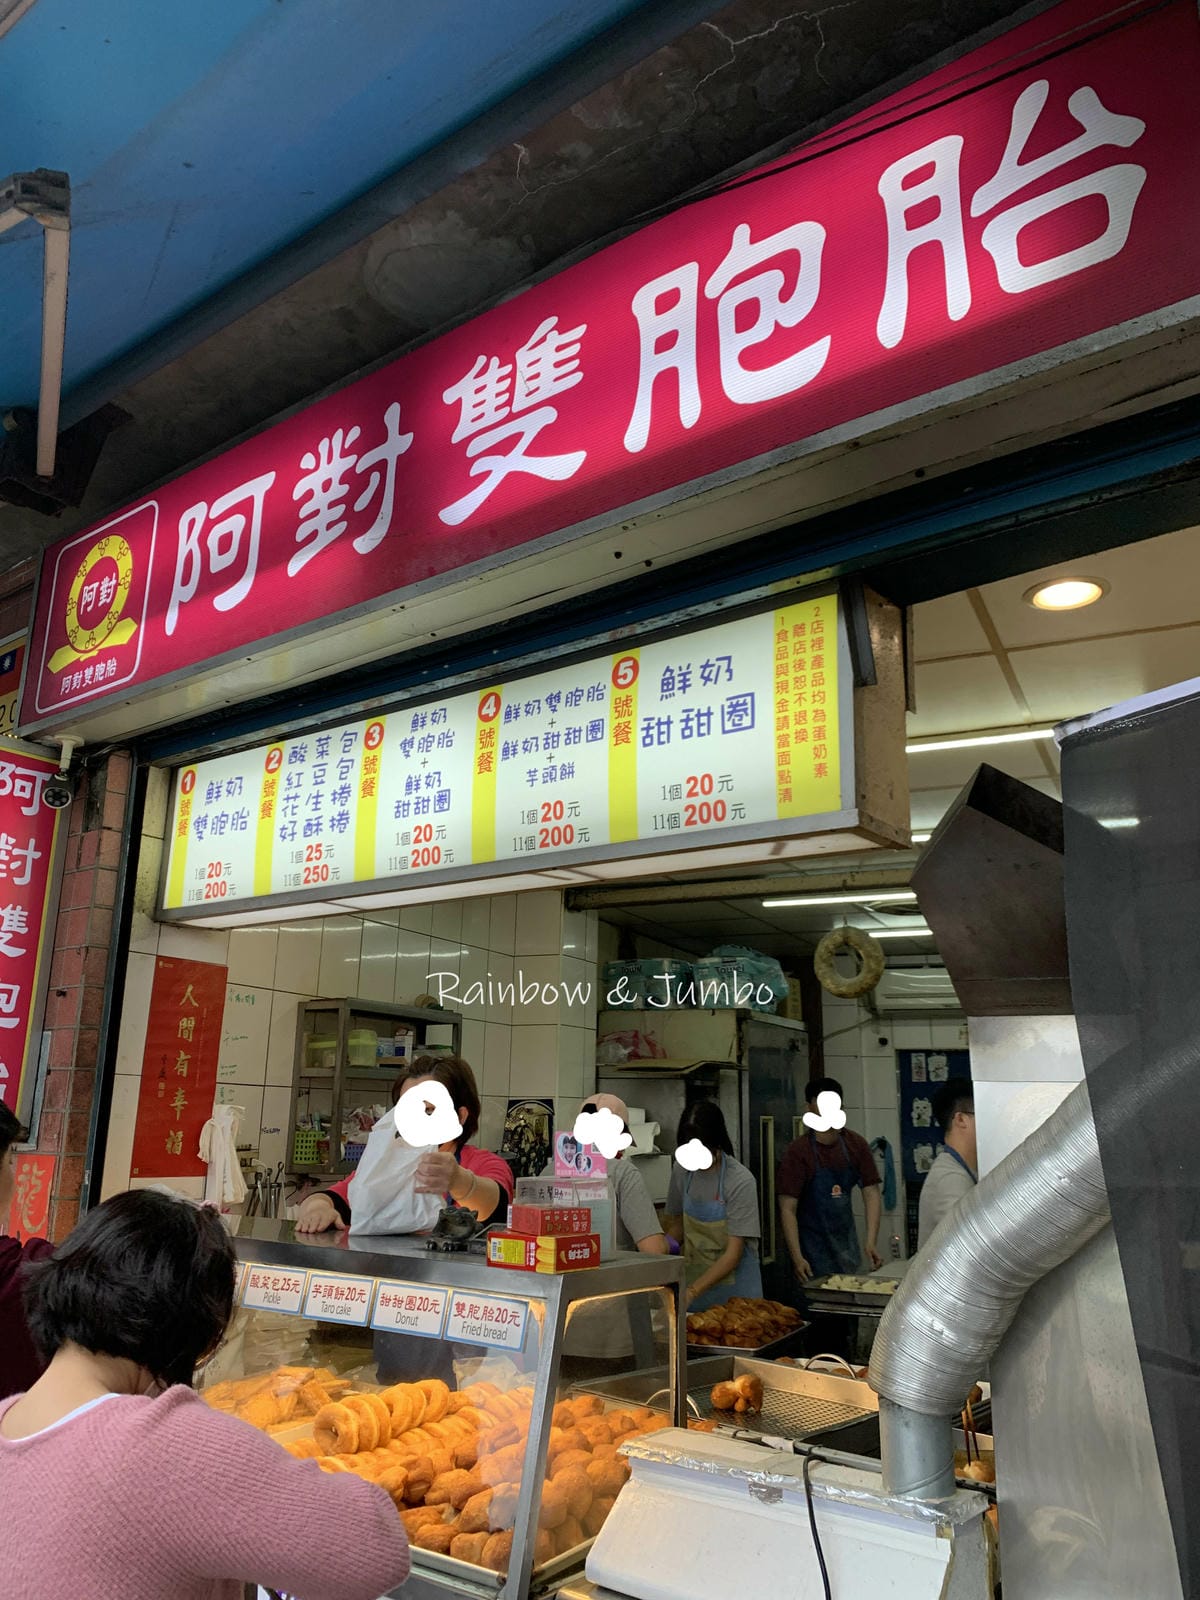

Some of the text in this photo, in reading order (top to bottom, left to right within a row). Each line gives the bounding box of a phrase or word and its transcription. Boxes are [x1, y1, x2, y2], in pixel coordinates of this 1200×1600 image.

[164, 79, 1148, 637] 阿對雙胞胎
[80, 572, 117, 615] 阿對
[60, 657, 118, 696] 阿對雙胞胎
[660, 655, 734, 702] 鮮奶
[503, 682, 606, 725] 鮮奶雙胞胎
[410, 708, 448, 733] 鮮奶
[641, 692, 756, 748] 甜甜圈
[288, 731, 359, 766] 酸菜包
[400, 728, 455, 760] 雙胞胎
[501, 718, 605, 762] 鮮奶甜甜圈
[285, 757, 355, 791] 紅豆包
[405, 771, 442, 796] 鮮奶
[526, 762, 576, 788] 芋頭餅
[205, 776, 243, 806] 鮮奶
[394, 789, 451, 819] 甜甜圈
[193, 807, 250, 841] 雙胞胎
[262, 1291, 282, 1305] Pickle
[321, 1301, 352, 1316] Taro cake
[395, 1312, 419, 1327] Donut
[453, 1301, 521, 1328] 雙胞胎20元
[461, 1321, 508, 1341] Fried bread
